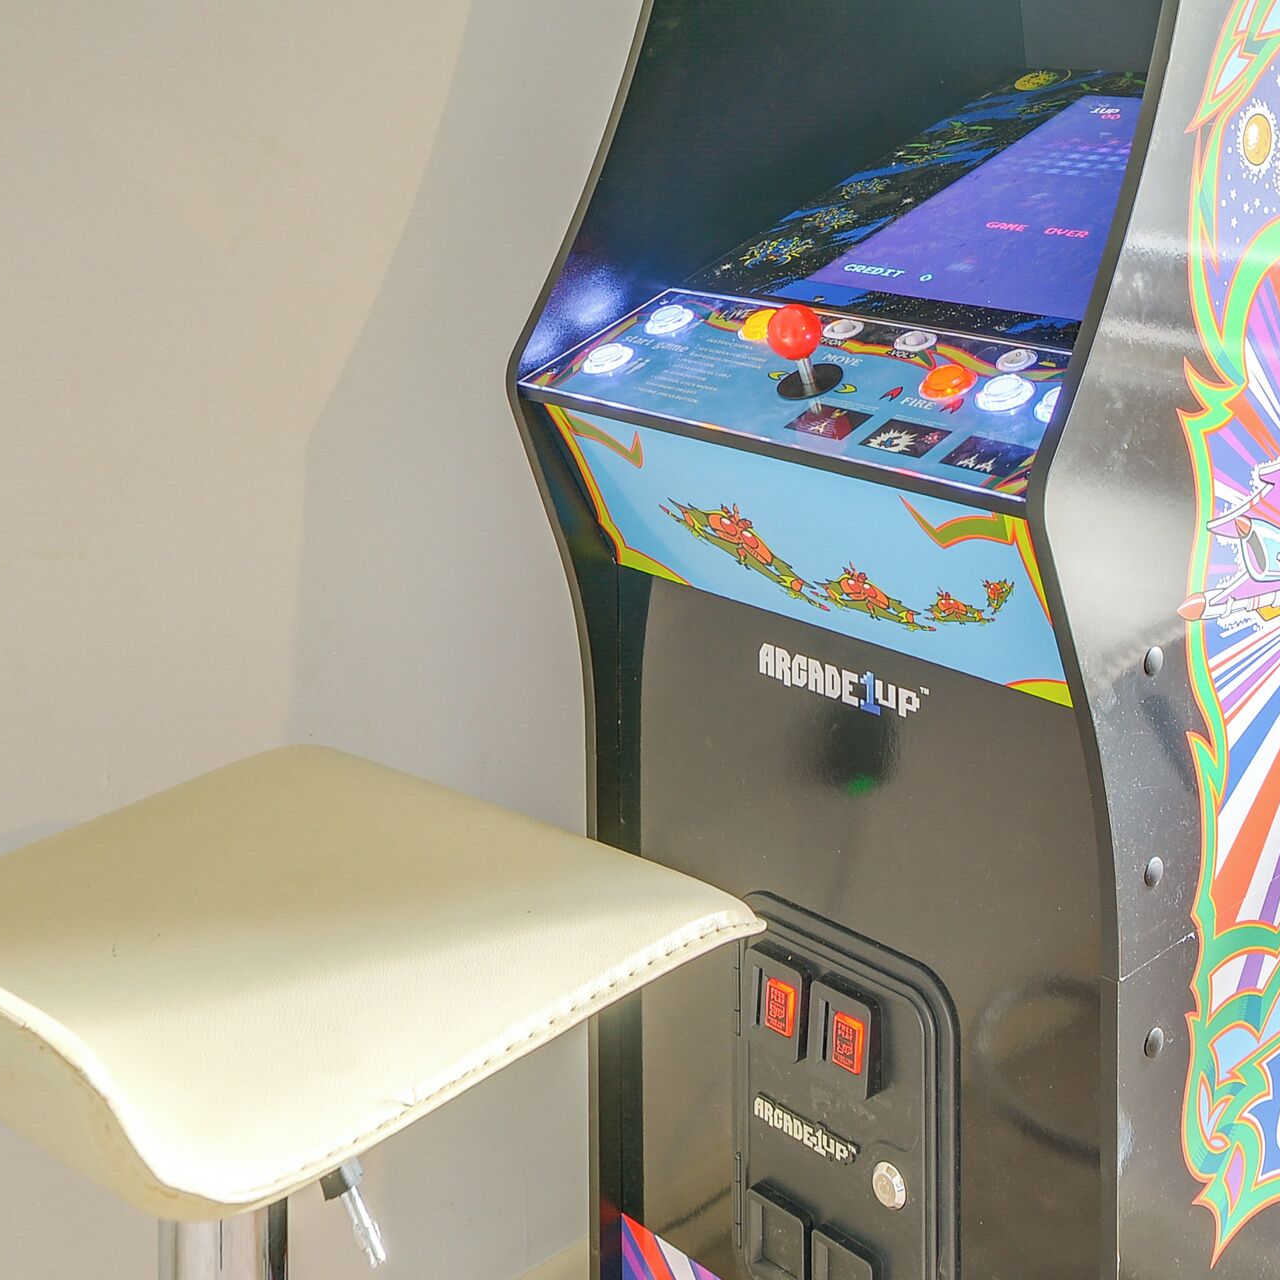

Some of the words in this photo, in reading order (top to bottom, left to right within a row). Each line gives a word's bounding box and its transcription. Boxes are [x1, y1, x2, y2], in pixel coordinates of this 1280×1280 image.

[985, 221, 1030, 232] GAME
[1043, 227, 1090, 238] OVER
[843, 263, 907, 278] CREDIT
[651, 342, 689, 353] game
[821, 353, 863, 367] MOVE
[900, 397, 937, 411] FIRE
